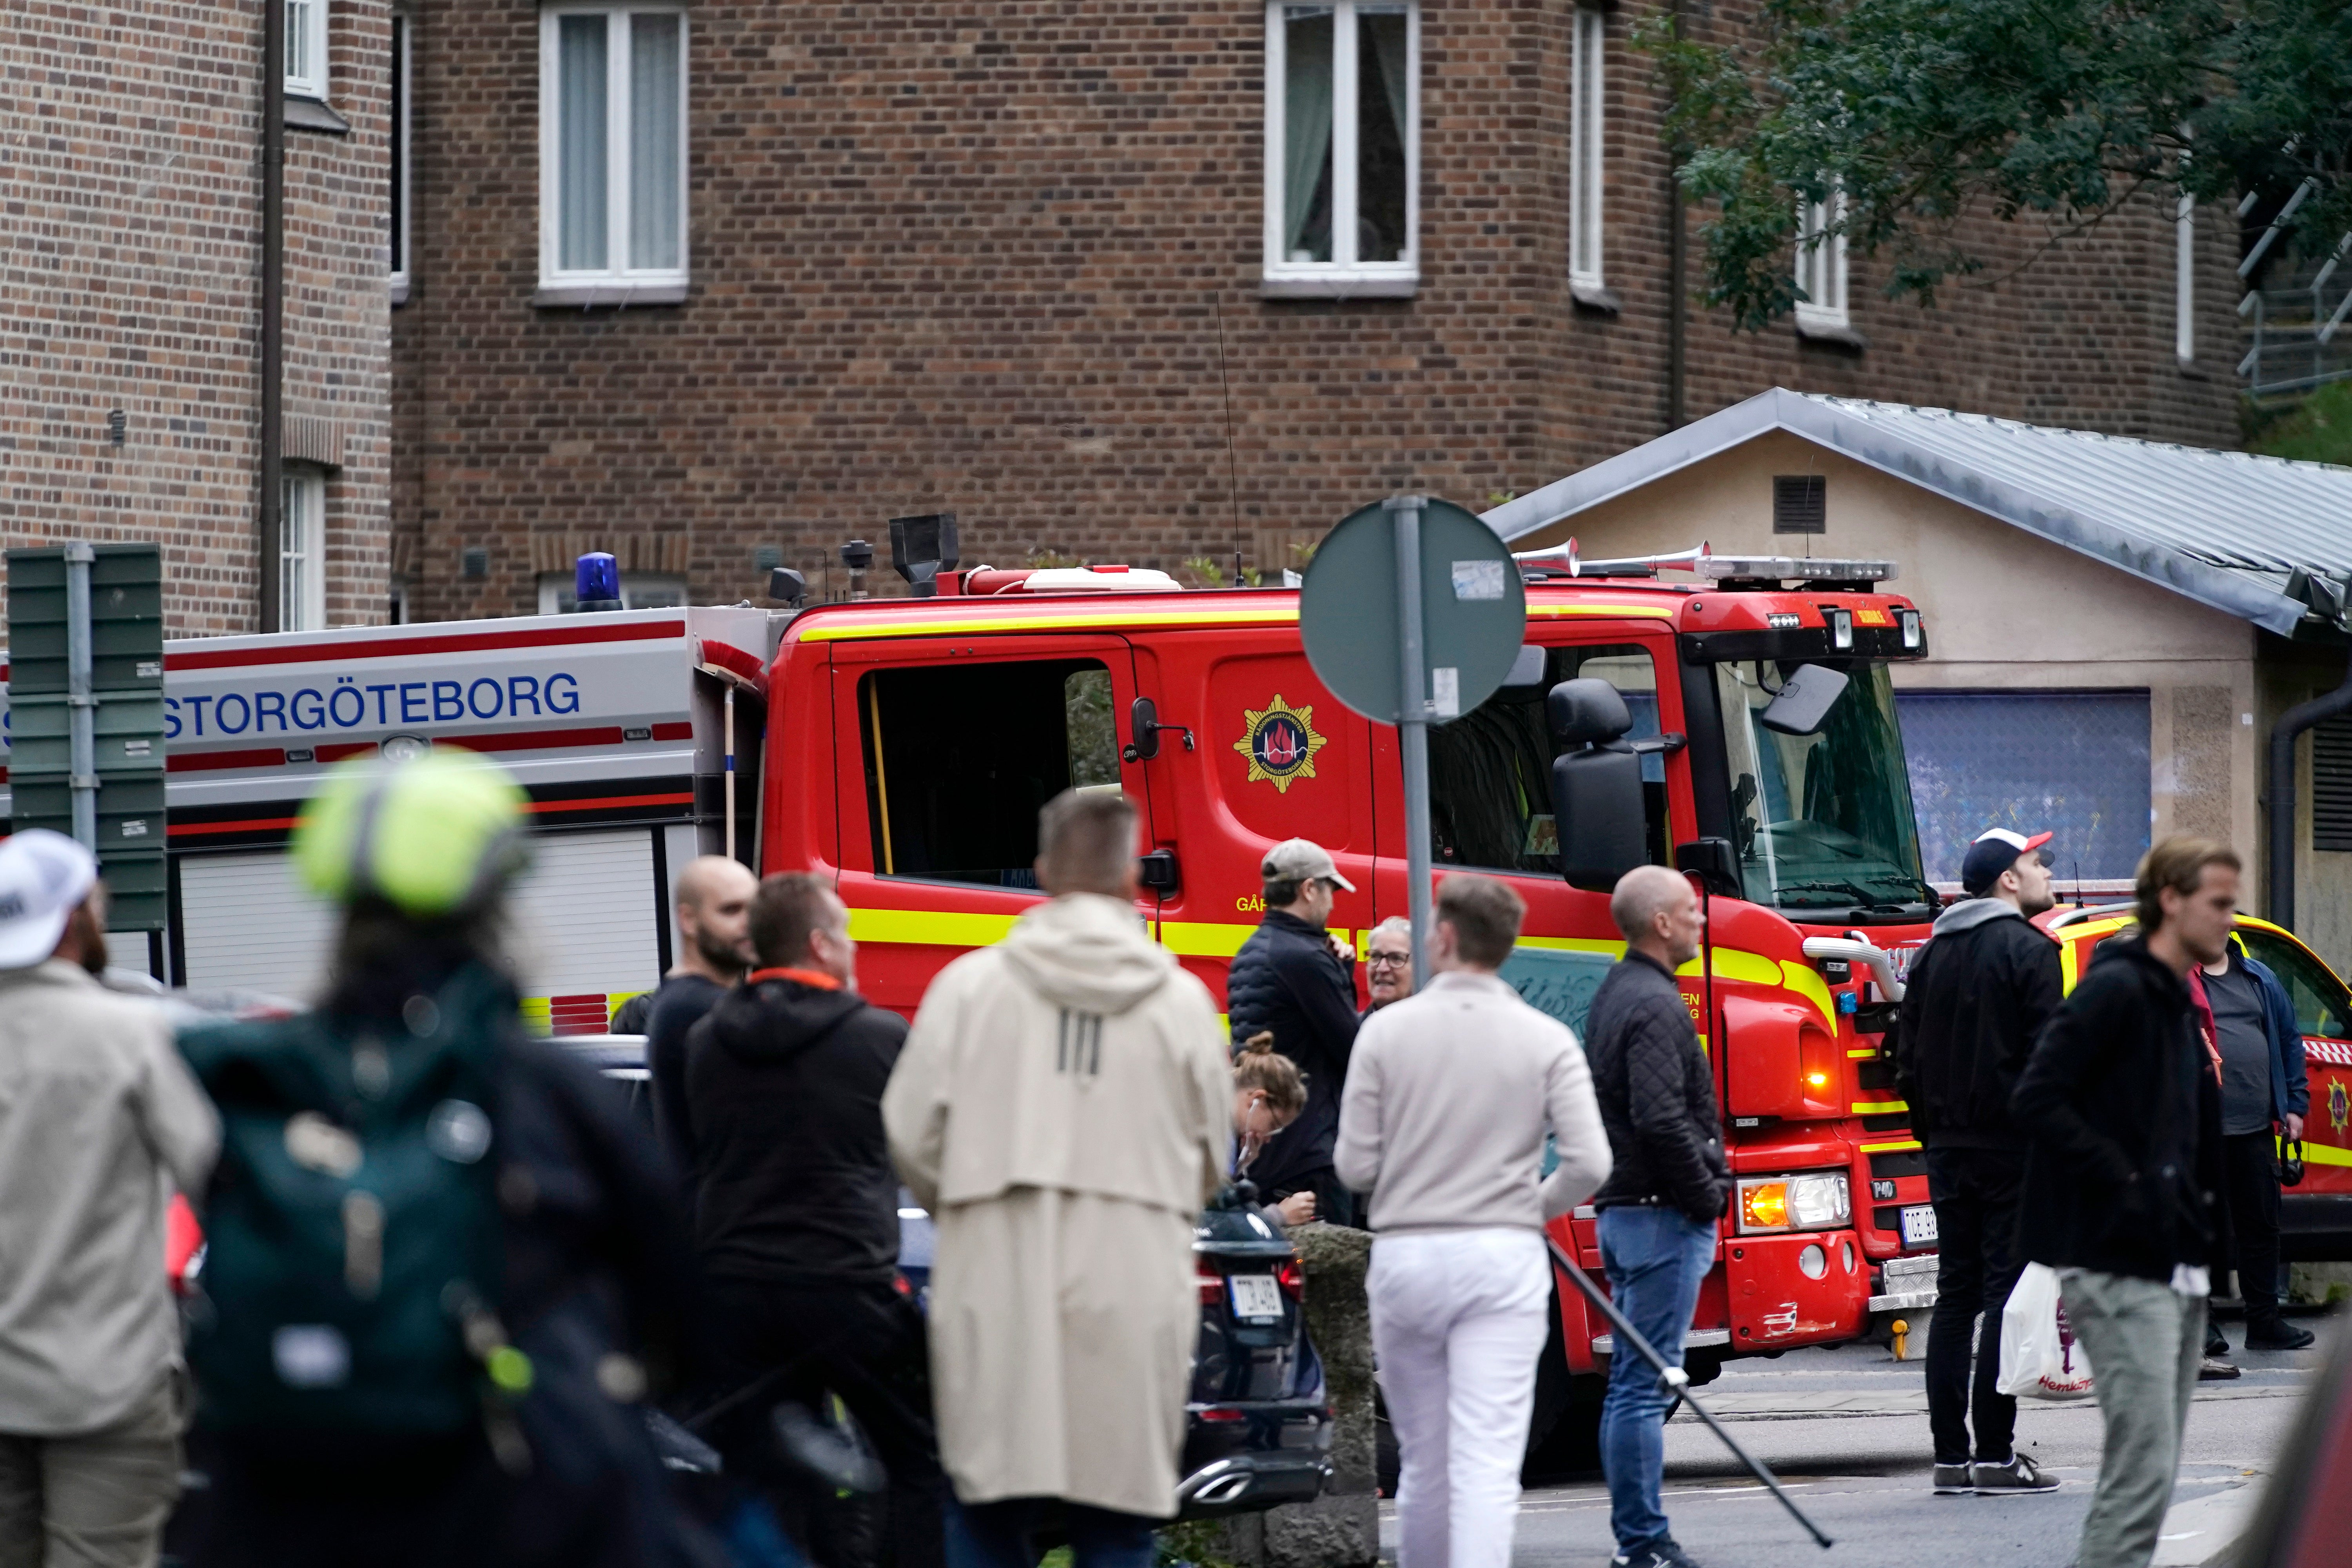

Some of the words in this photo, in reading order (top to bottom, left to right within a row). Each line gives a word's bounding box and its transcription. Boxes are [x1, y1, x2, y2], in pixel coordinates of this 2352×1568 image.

[165, 673, 579, 739] STORGÖTEBORG
[1255, 713, 1304, 736] RÄDDNINGSTJÄNSTEN
[1260, 759, 1302, 775] STORGÖTEBORG
[1679, 993, 1700, 1005] EN
[1906, 1212, 1922, 1238] TCE
[1926, 1211, 1936, 1236] 93
